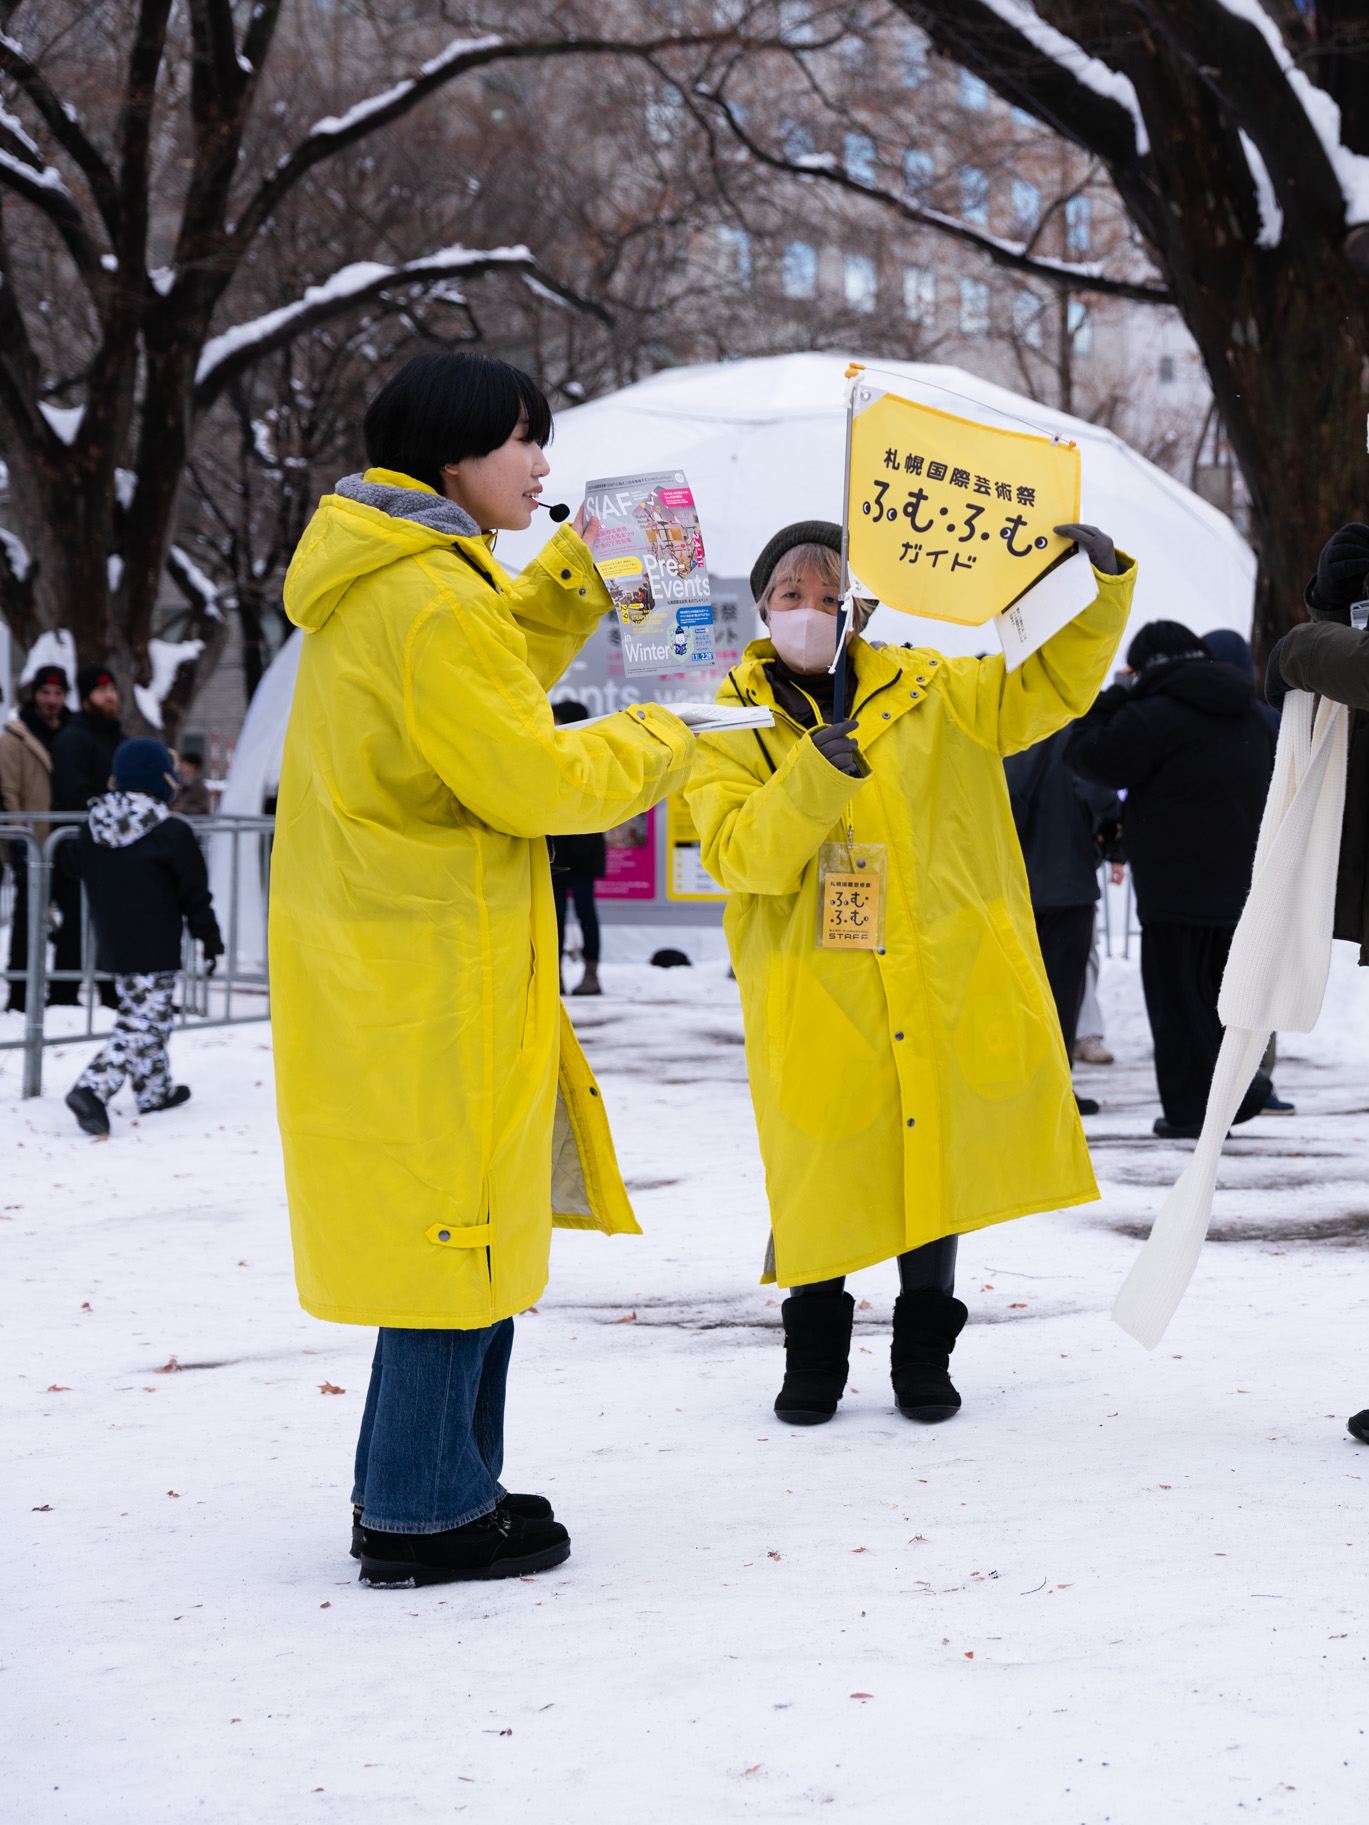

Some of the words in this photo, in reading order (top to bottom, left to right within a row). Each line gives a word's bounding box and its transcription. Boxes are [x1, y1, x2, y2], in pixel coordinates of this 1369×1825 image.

[883, 447, 1036, 508] 札幌国際芸術祭
[585, 491, 633, 522] SIAF
[643, 554, 685, 578] Pre-
[898, 541, 978, 572] ガイド
[648, 573, 711, 600] Events
[623, 632, 632, 643] in
[624, 643, 670, 663] Winter
[830, 909, 869, 926] ふむ
[828, 932, 869, 940] STAFF
